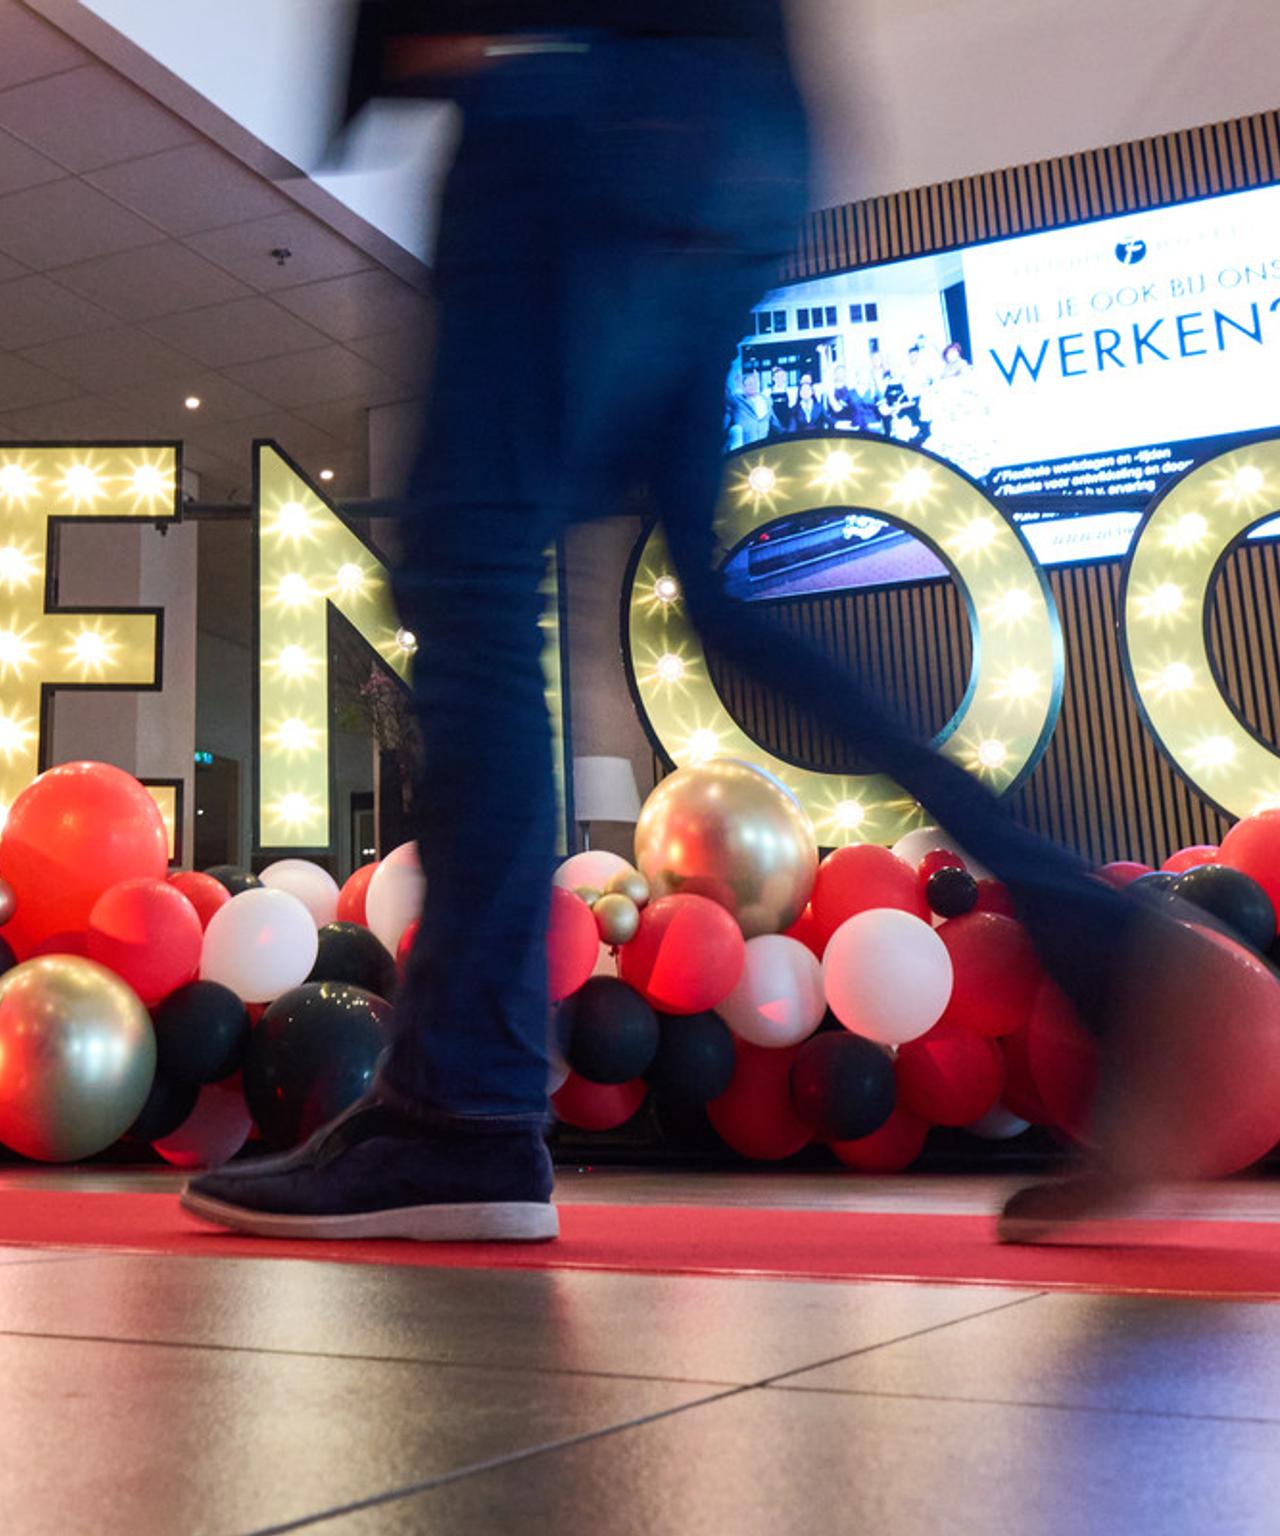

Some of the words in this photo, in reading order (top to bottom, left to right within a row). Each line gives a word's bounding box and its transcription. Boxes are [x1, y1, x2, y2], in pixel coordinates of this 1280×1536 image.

[995, 303, 1040, 328] WIL
[1057, 298, 1074, 320] JE
[1090, 282, 1158, 312] OOK
[1170, 274, 1206, 298] BIJ
